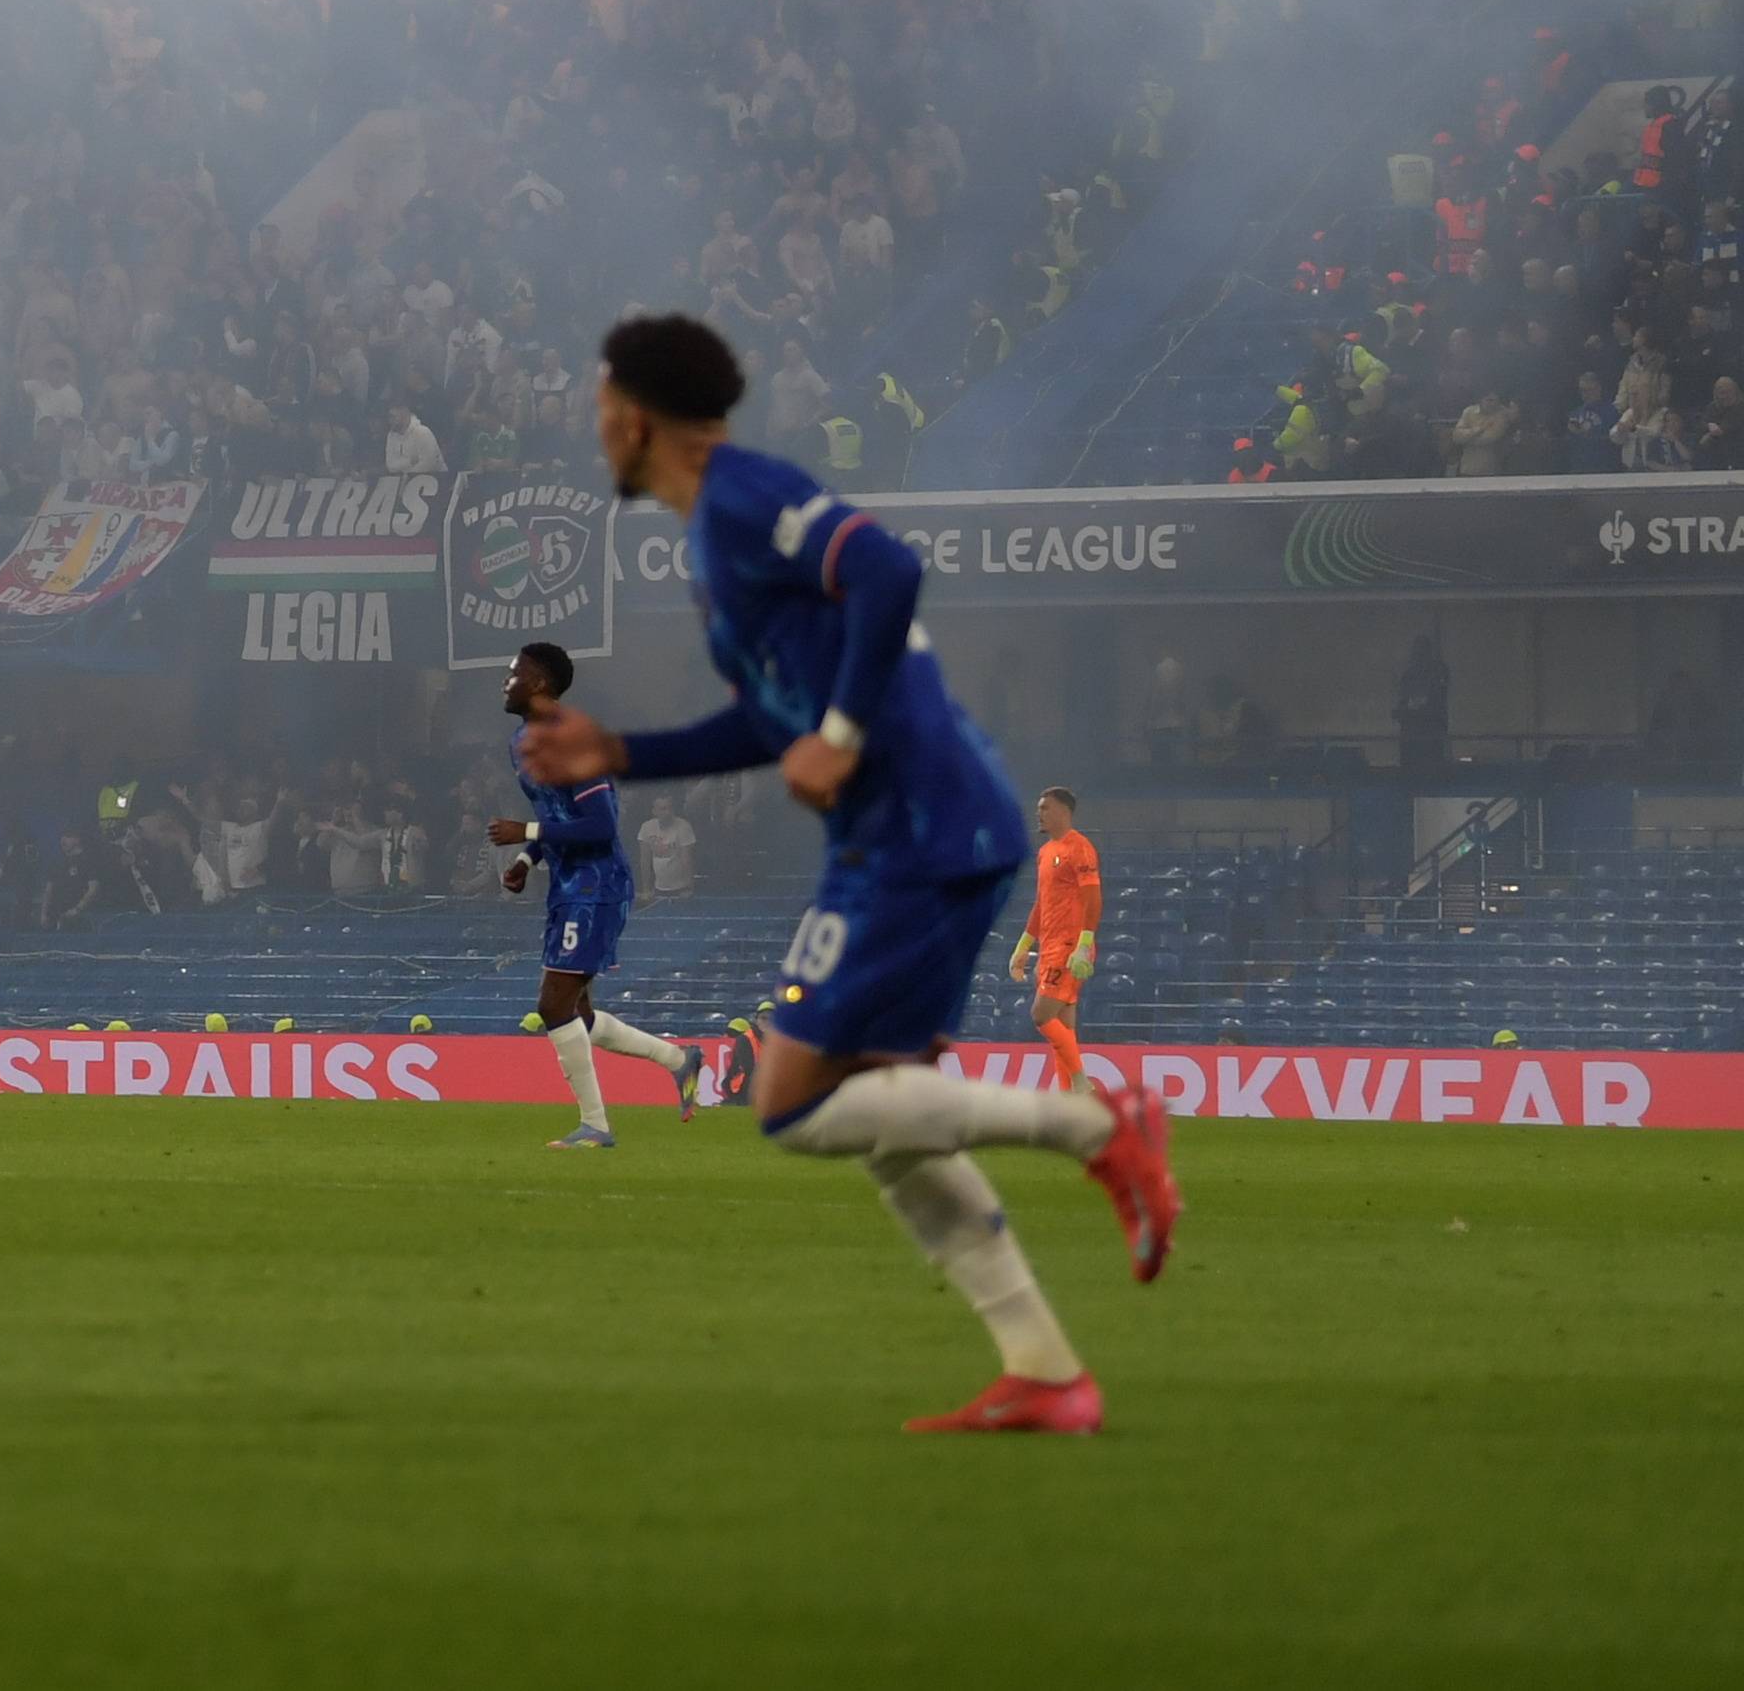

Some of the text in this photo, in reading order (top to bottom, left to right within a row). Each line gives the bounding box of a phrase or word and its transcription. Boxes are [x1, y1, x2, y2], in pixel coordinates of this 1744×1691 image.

[230, 474, 439, 541] ULTRAS
[462, 485, 606, 528] RADOMSCY
[981, 524, 1177, 573] LEAGUE
[241, 590, 393, 662] LEGIA
[460, 583, 591, 630] CHULIGANI
[562, 921, 579, 951] 5
[780, 907, 849, 984] 19
